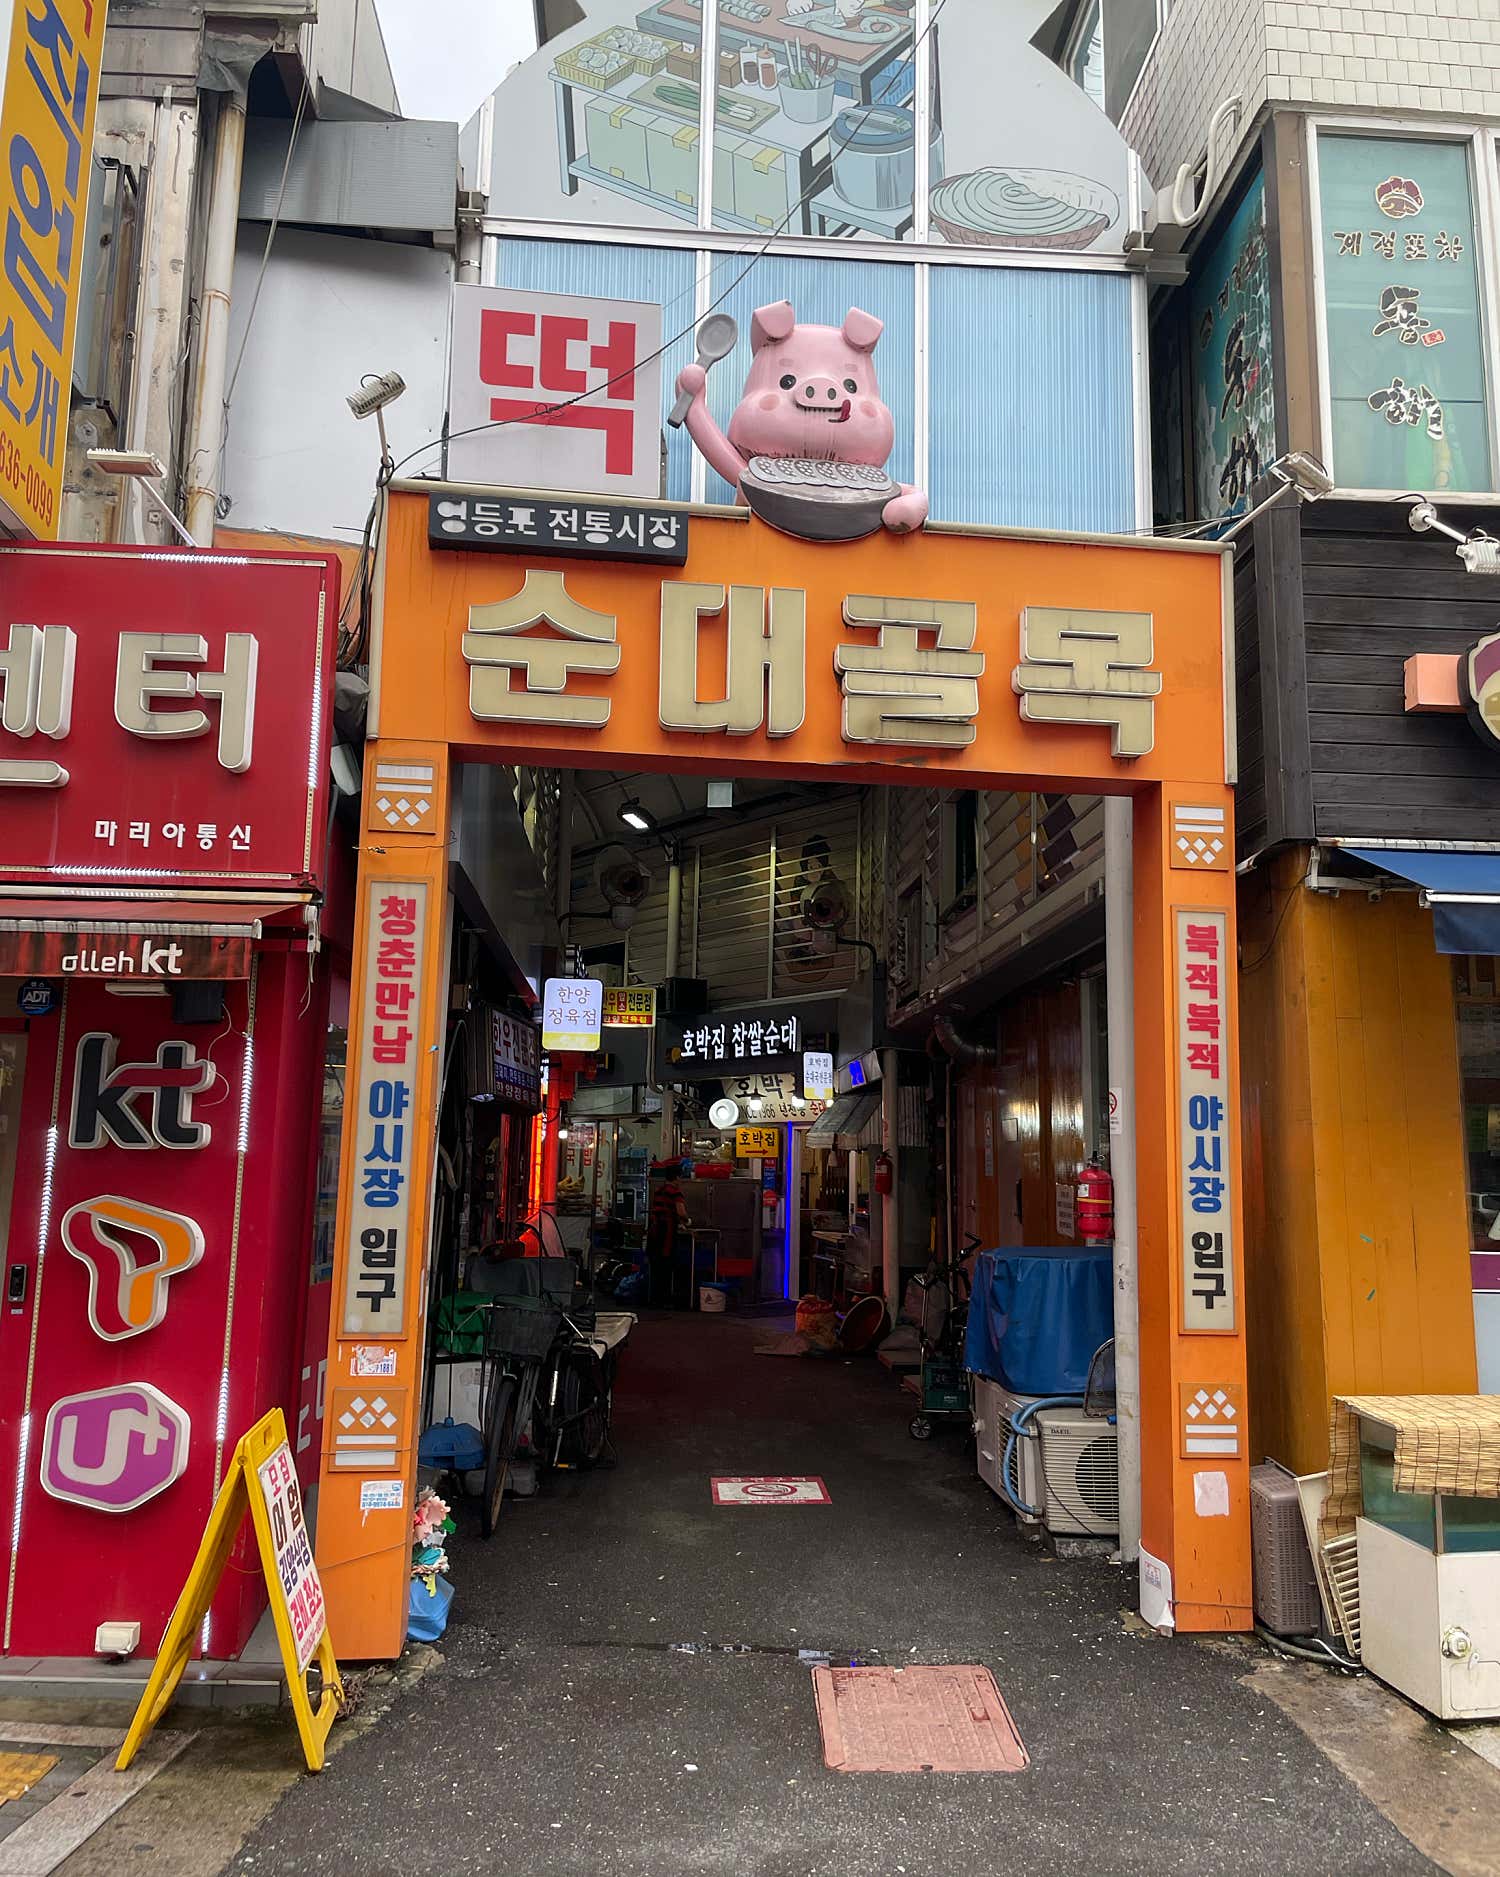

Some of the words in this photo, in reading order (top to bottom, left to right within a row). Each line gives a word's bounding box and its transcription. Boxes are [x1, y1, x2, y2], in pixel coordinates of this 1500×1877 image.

[480, 308, 637, 477] 떡
[436, 500, 539, 536] 영등포
[548, 508, 682, 549] 전통시장
[460, 568, 1163, 759] 순대골목
[94, 820, 254, 851] 마리아통신
[61, 953, 135, 974] olleh
[141, 939, 183, 974] kt
[372, 895, 418, 1065] 청춘만남
[557, 986, 592, 1005] 한양
[23, 990, 51, 1004] ADT
[548, 1008, 598, 1026] 정육점
[1184, 923, 1221, 1081] 북적북적
[680, 1023, 726, 1060] 호박집
[731, 1015, 797, 1058] 찹쌀순대
[68, 1032, 217, 1150] kt
[361, 1079, 410, 1209] 야시장
[739, 1130, 775, 1147] 호박집
[1187, 1094, 1226, 1214] 야시장
[356, 1227, 397, 1313] 입구
[1191, 1230, 1227, 1310] 입구
